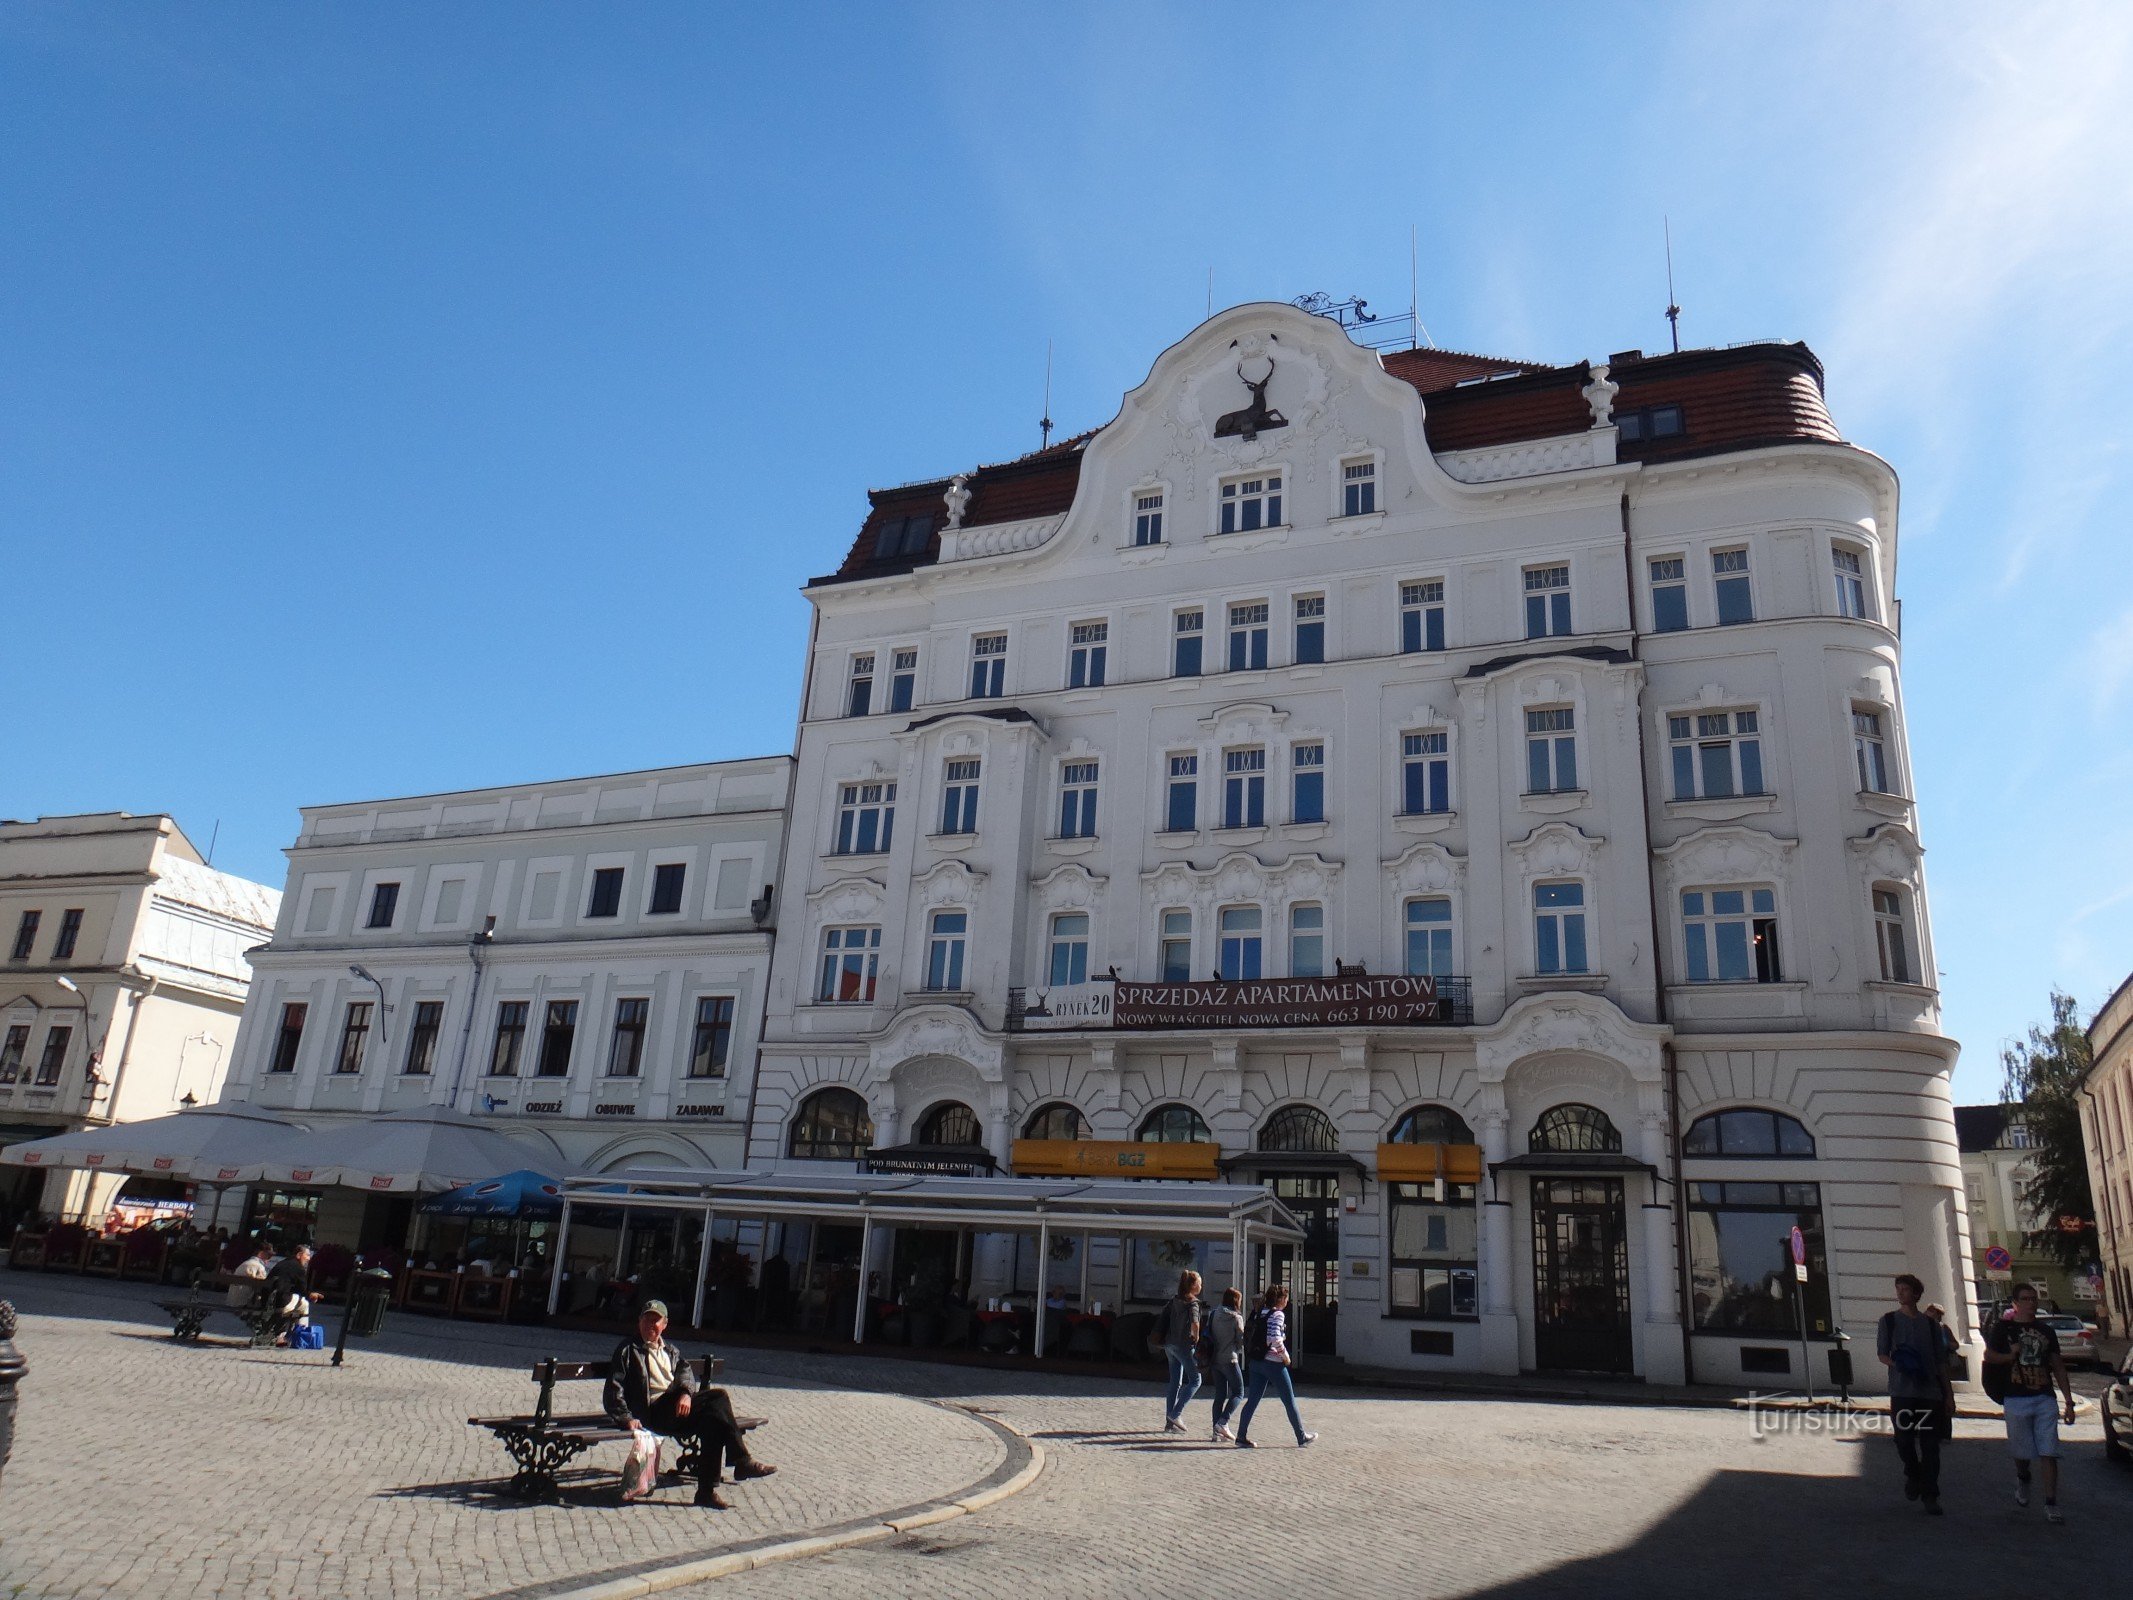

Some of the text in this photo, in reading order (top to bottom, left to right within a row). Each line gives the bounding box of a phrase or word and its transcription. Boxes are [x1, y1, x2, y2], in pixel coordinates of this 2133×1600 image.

[1117, 974, 1434, 1006] SPRZEDAŻ APARTAMENTÓW
[1056, 1002, 1090, 1016] RYNEK
[1091, 994, 1110, 1015] 20
[1116, 1012, 1155, 1025] NOWY
[1239, 1012, 1280, 1025] NOWA
[1327, 1006, 1360, 1023] 663
[1367, 1004, 1399, 1020] 190
[1405, 1002, 1437, 1019] 797
[526, 1100, 562, 1113] ODZIEŻ
[594, 1104, 636, 1115] OBUWIE
[676, 1105, 725, 1116] ZABAWKI
[868, 1160, 884, 1168] POD
[885, 1160, 935, 1170] BRUNATNYM
